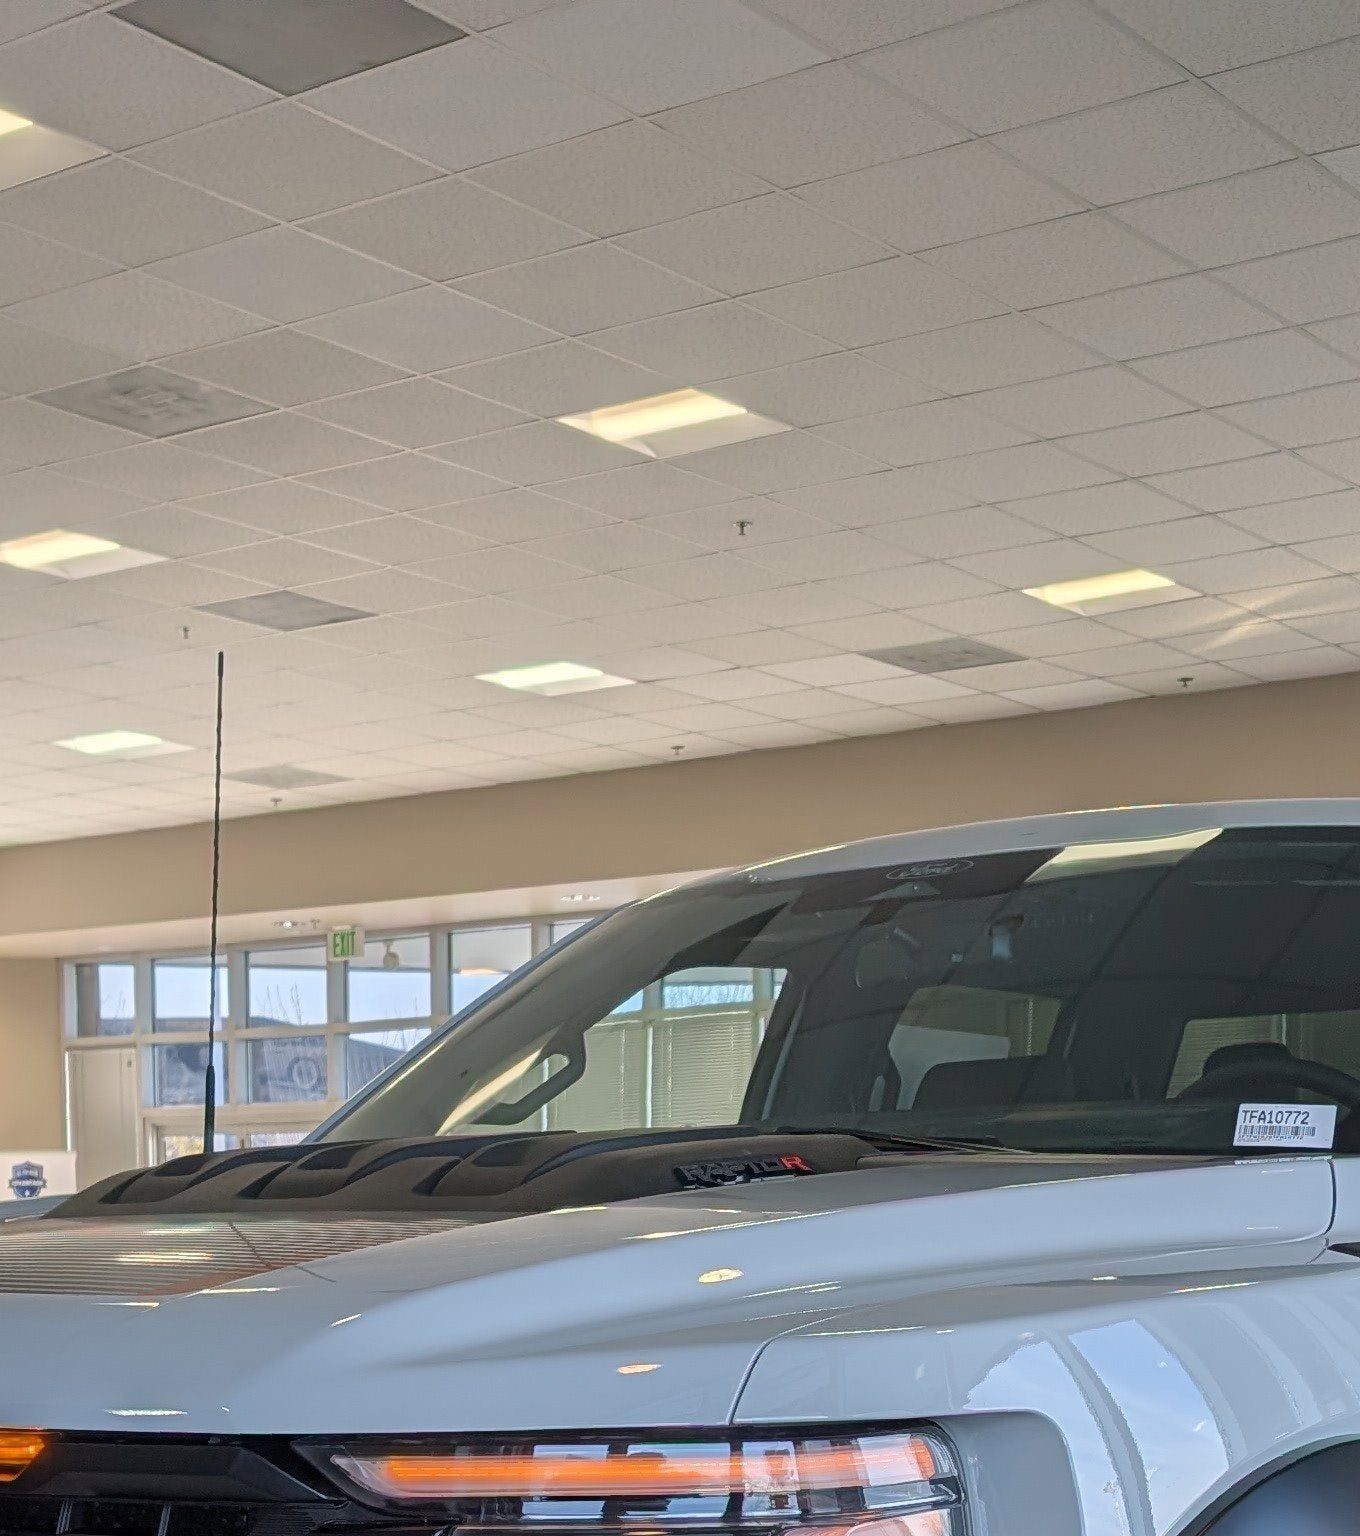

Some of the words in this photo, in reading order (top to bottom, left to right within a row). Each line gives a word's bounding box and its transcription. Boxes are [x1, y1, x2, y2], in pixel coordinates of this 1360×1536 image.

[332, 931, 355, 957] EXIT
[1241, 1109, 1310, 1125] TFA10772
[678, 1154, 815, 1183] RAPTOR
